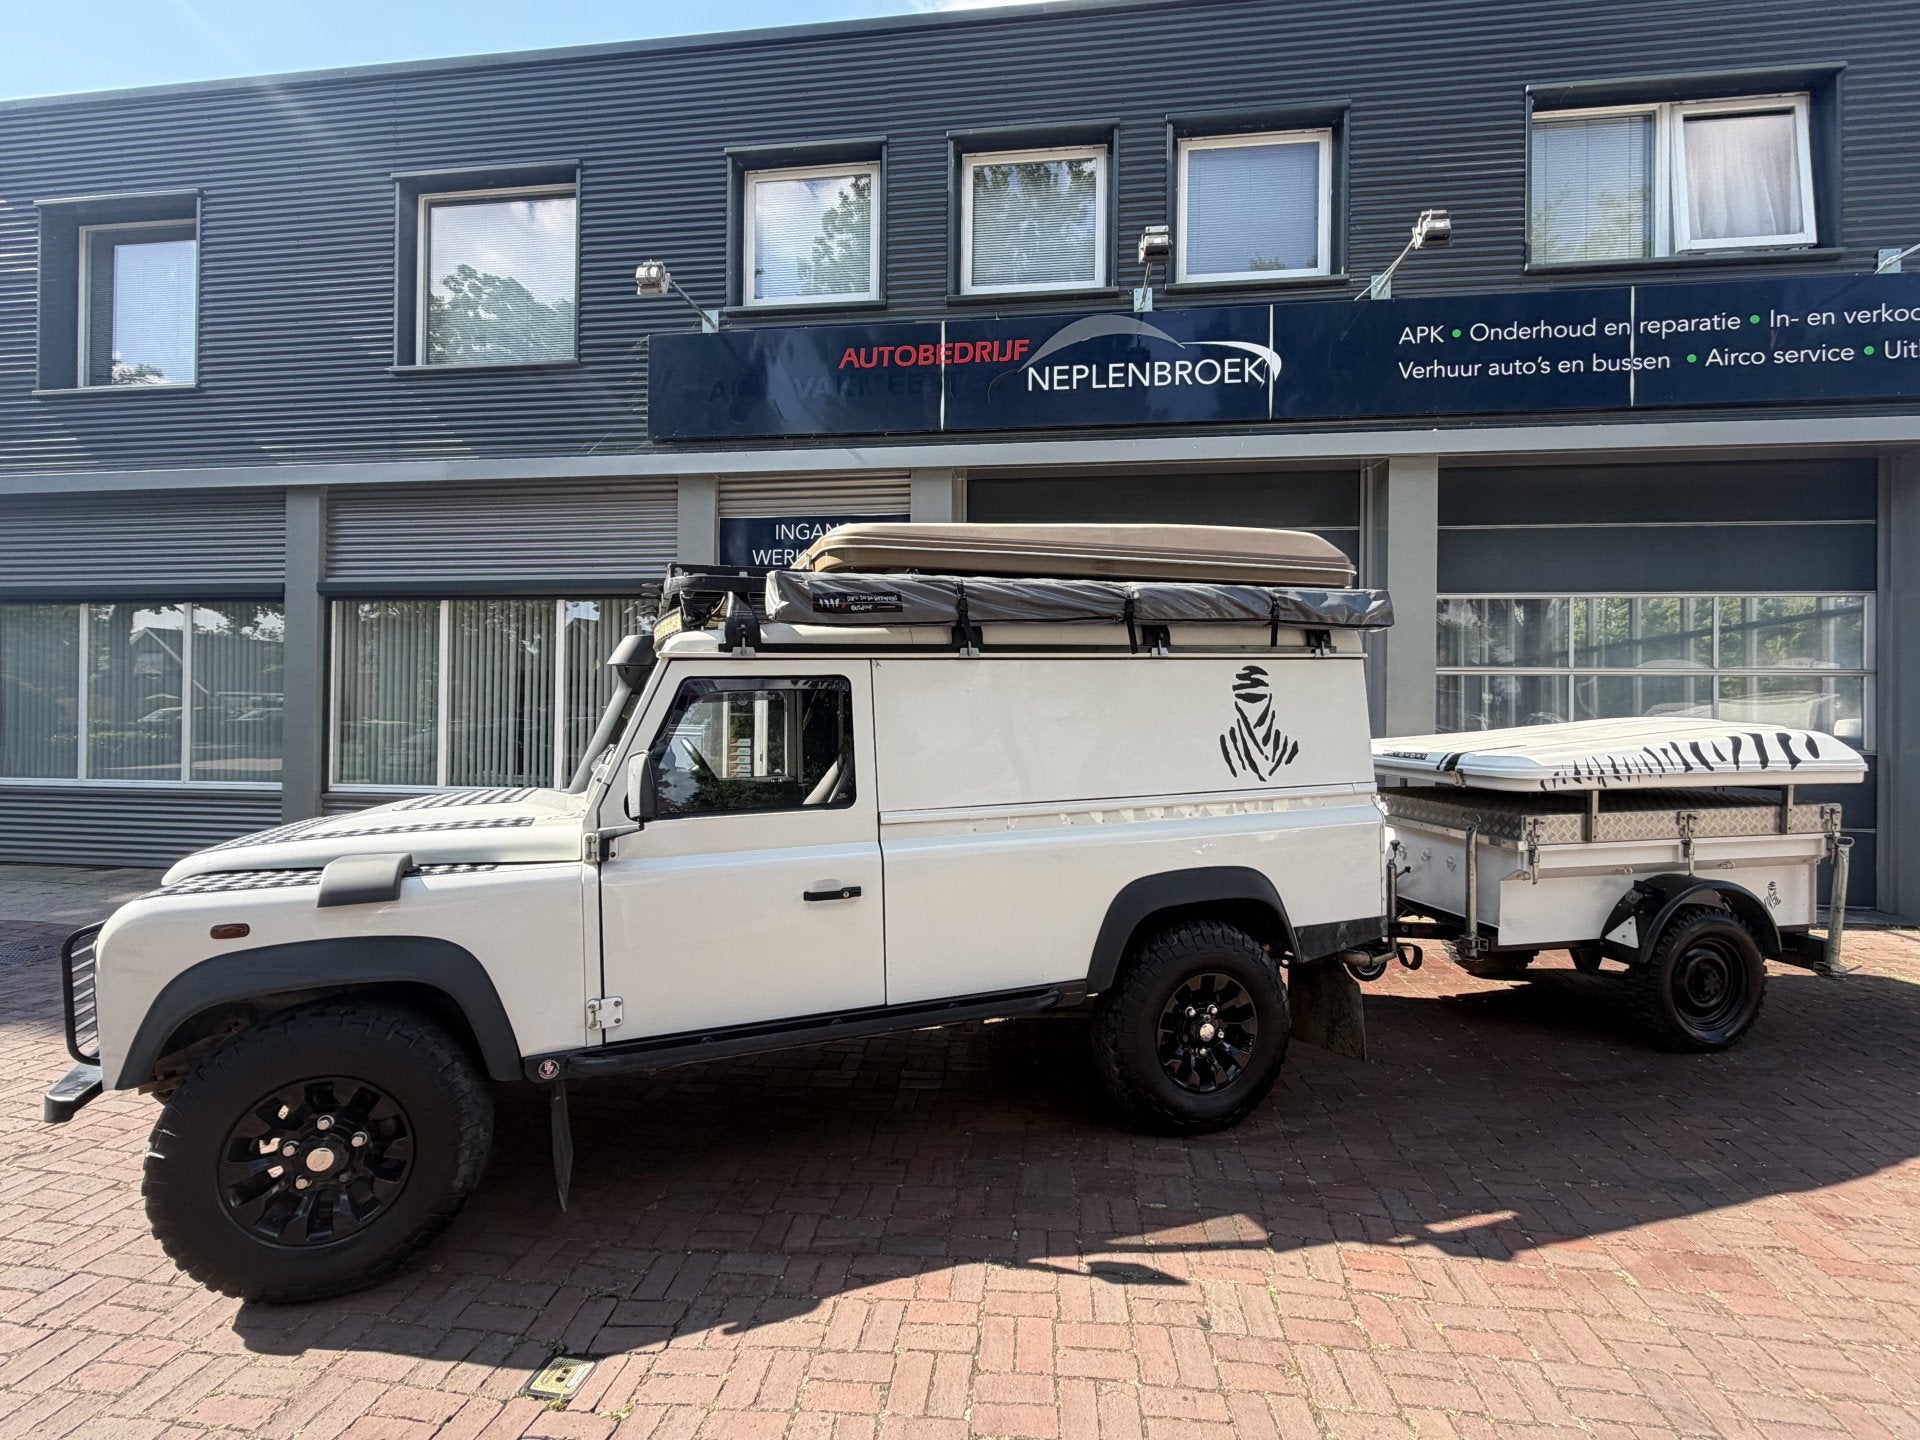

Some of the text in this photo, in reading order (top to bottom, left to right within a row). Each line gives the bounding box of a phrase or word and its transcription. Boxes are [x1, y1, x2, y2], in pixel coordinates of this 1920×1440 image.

[1398, 324, 1445, 345] APK
[1469, 317, 1597, 342] Onderhoud
[1604, 321, 1631, 336] en
[1640, 312, 1741, 340] reparatie
[1770, 309, 1800, 328] In-
[1807, 311, 1835, 326] en
[838, 339, 1030, 369] AUTOBEDRIJF
[1398, 340, 1920, 380] Verhuur auto's en bussen Airco service Uit
[1027, 357, 1265, 392] NEPLENBROEK
